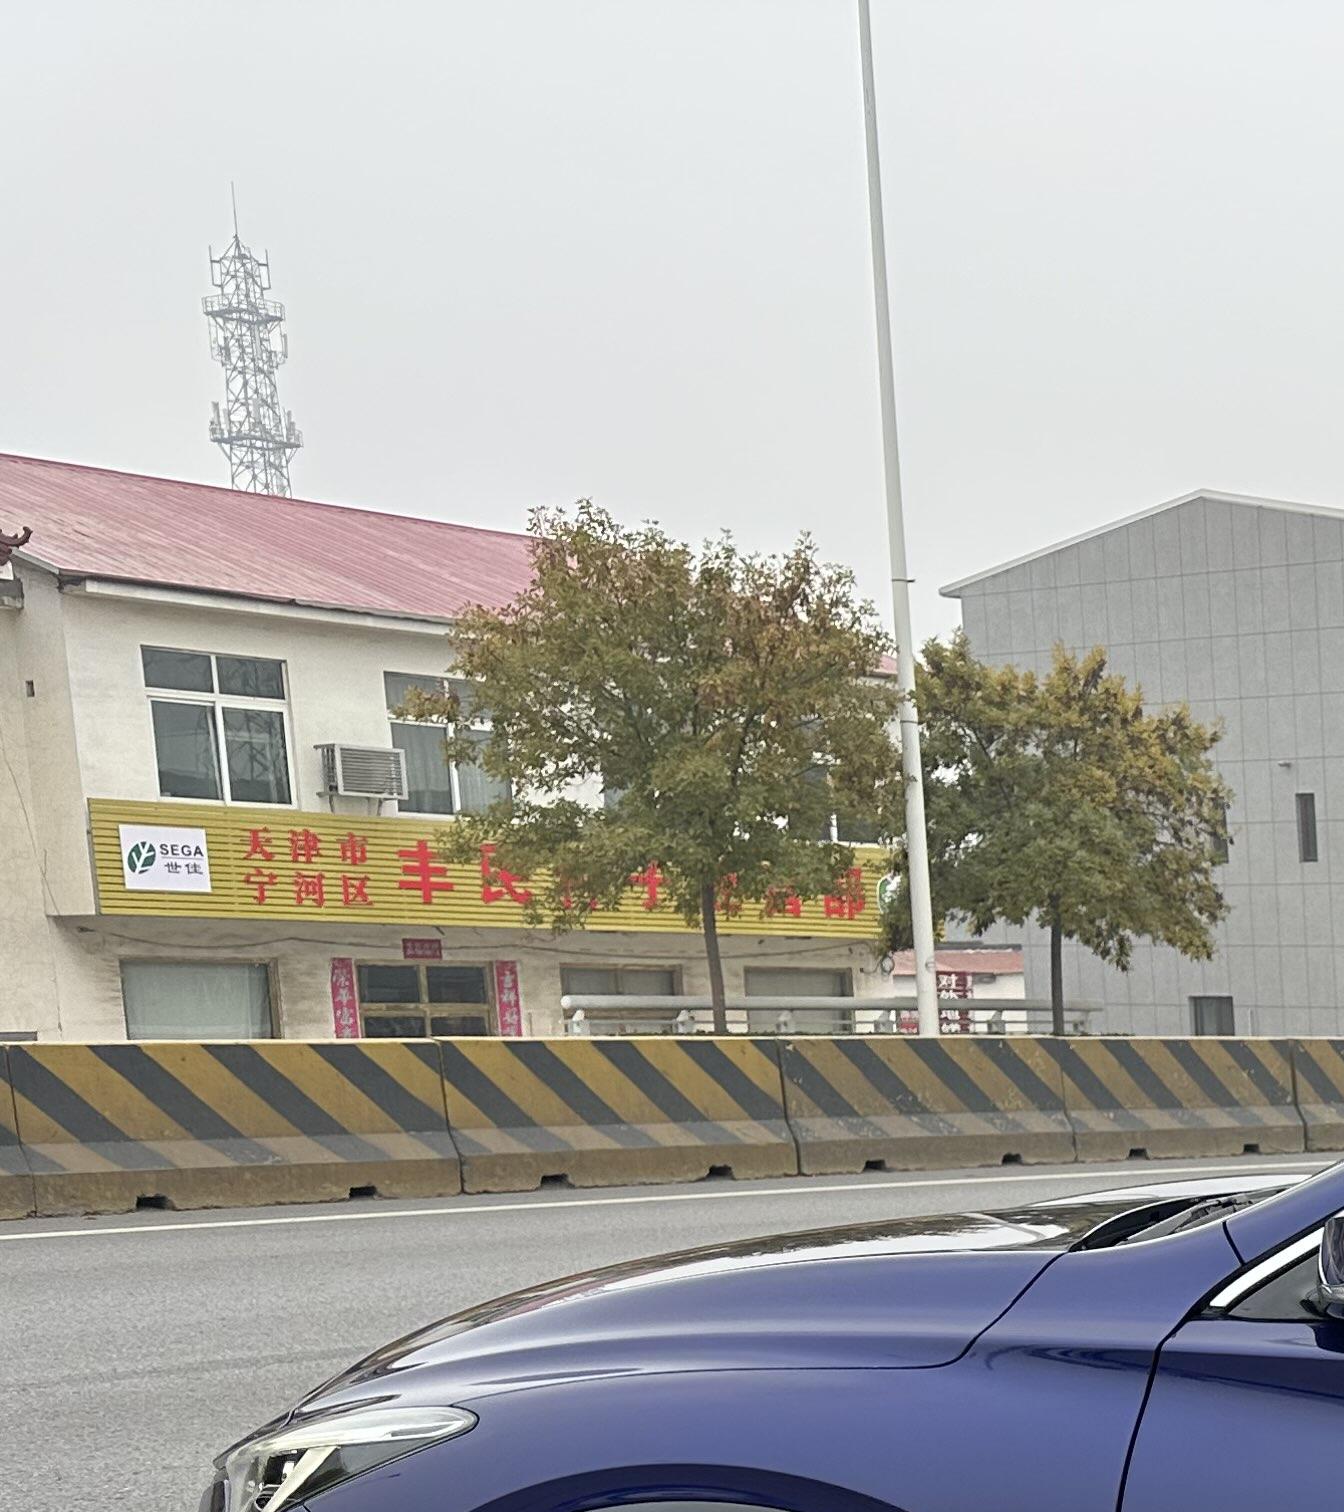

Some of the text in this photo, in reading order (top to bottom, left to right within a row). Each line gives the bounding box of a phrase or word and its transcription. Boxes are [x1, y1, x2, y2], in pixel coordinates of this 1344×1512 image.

[159, 843, 204, 857] SEGA
[240, 826, 369, 866] 天津市
[164, 861, 204, 876] 世佳
[244, 868, 374, 908] 宁河区
